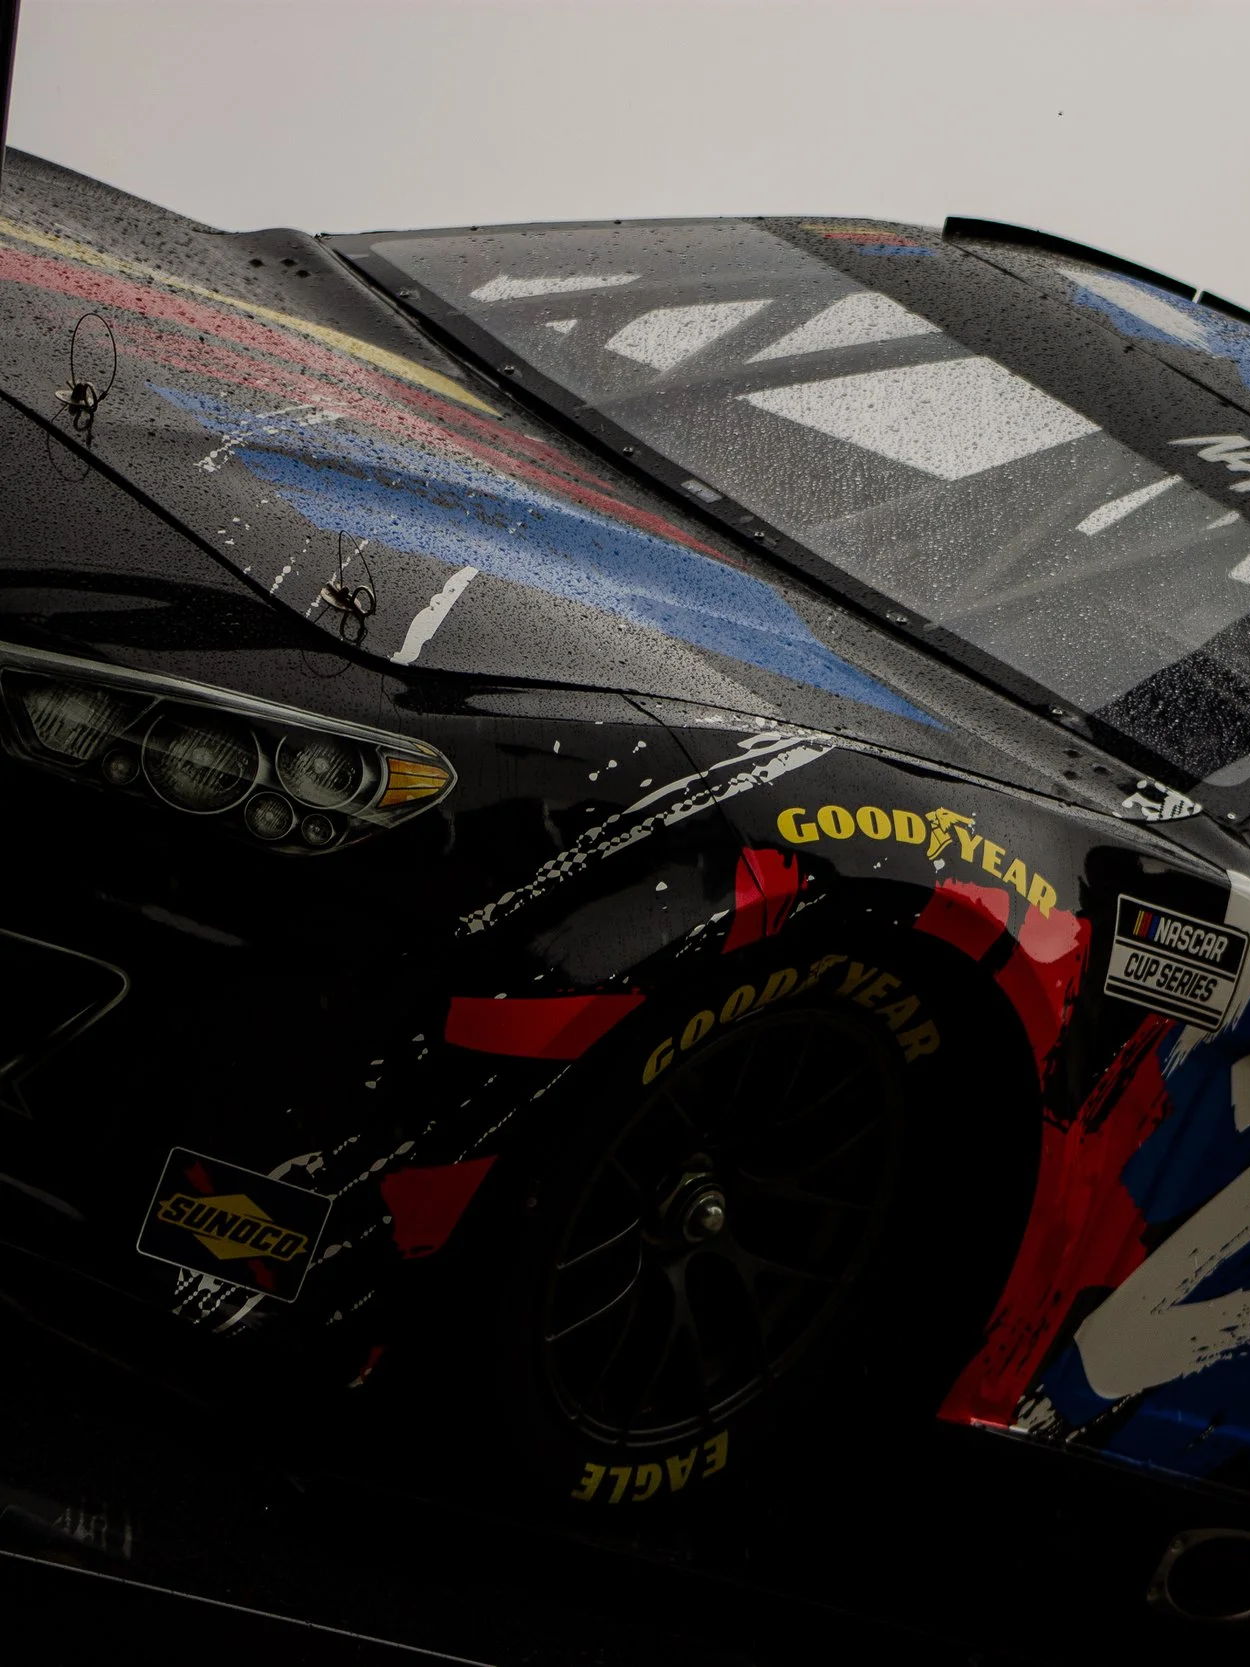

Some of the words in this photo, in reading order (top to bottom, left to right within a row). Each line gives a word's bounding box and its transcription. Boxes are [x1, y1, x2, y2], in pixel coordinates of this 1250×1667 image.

[776, 806, 1058, 918] GOODYEAR
[1154, 917, 1228, 962] NASCAR
[1125, 953, 1159, 982] CUP
[1157, 963, 1217, 1001] SERIES
[641, 953, 943, 1086] GOODYEAR
[163, 1195, 303, 1259] SUNOCO
[571, 1429, 730, 1504] EAGLE
